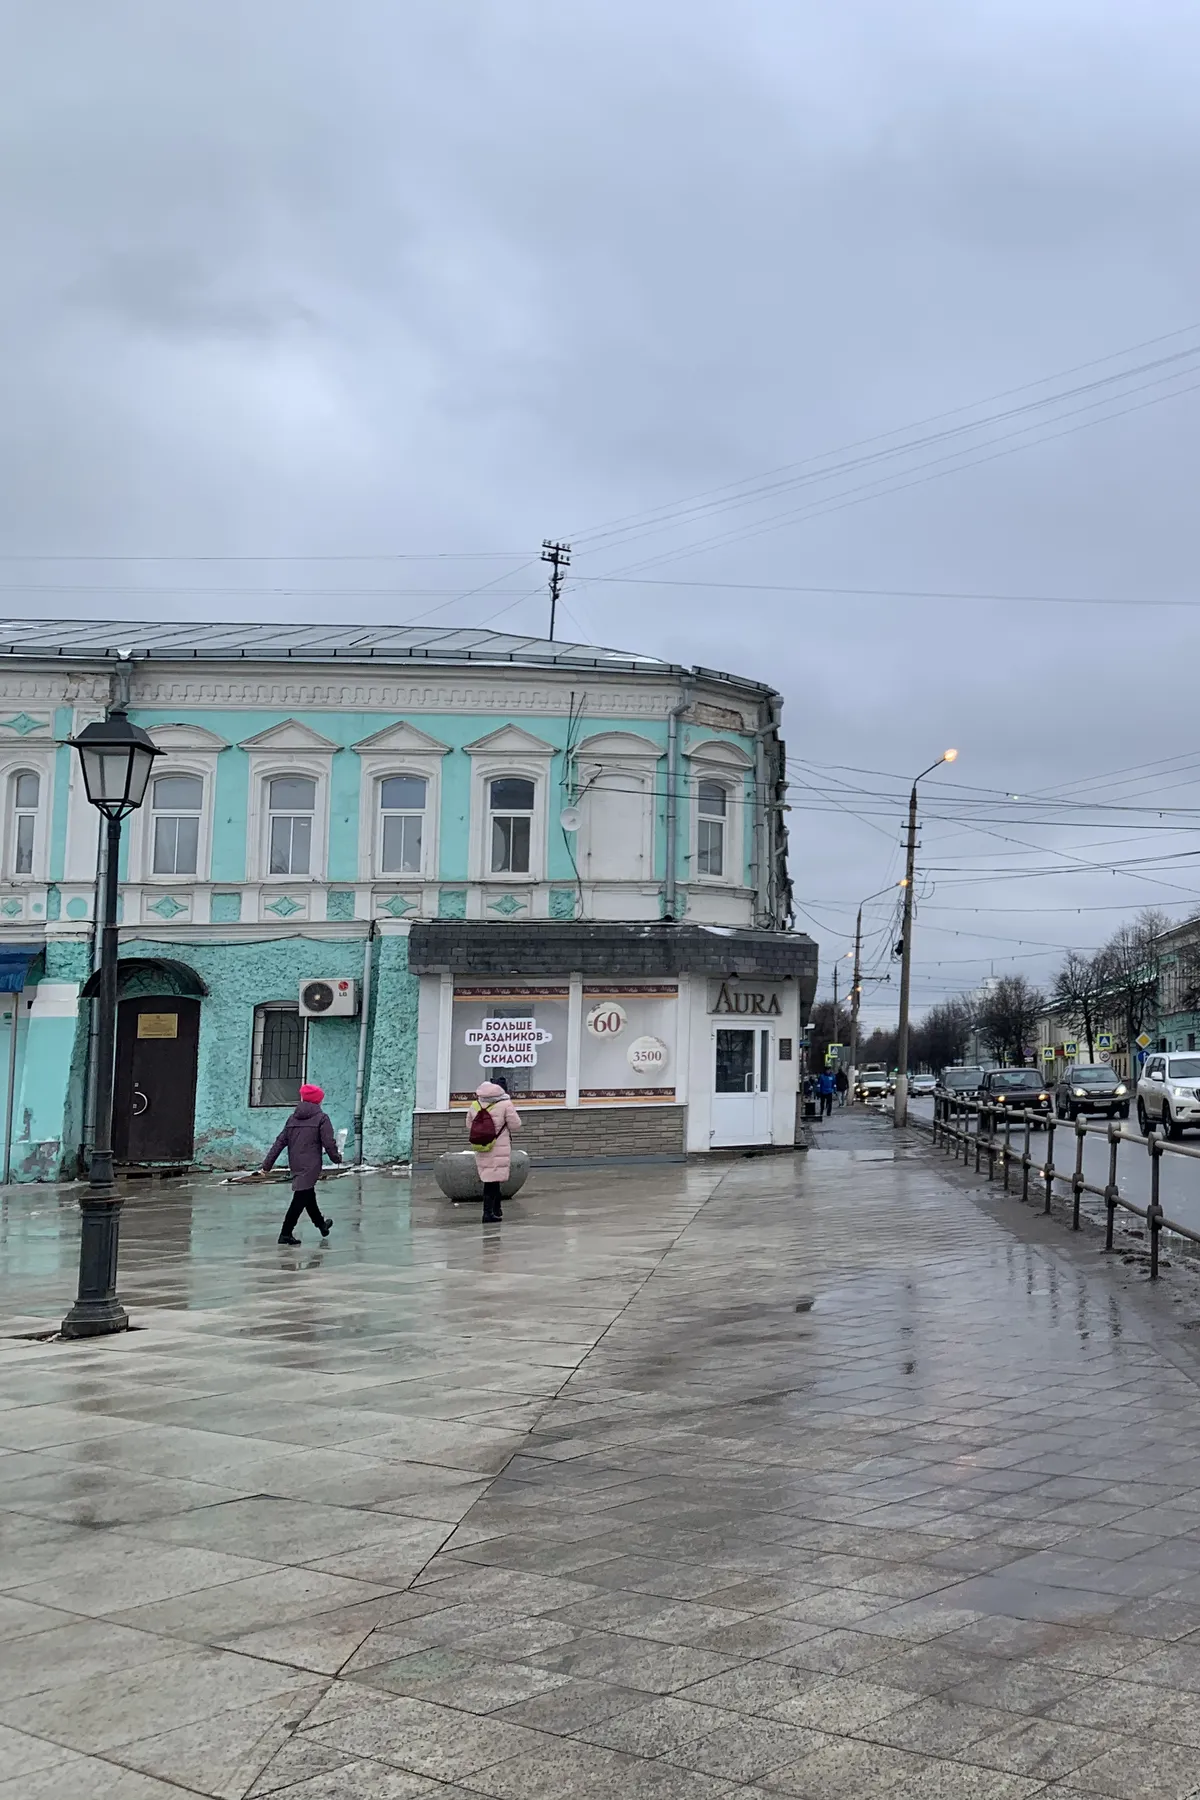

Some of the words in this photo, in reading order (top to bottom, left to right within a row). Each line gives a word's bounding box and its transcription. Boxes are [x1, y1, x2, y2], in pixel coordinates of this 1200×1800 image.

[712, 982, 782, 1014] AURA
[486, 1021, 532, 1031] БОЛЬШЕ
[469, 1032, 543, 1042] ПРАЗДНИКОВ
[485, 1043, 532, 1053] БОЛЬШЕ
[483, 1054, 533, 1064] СКИДОК!
[633, 1050, 662, 1062] 3500
